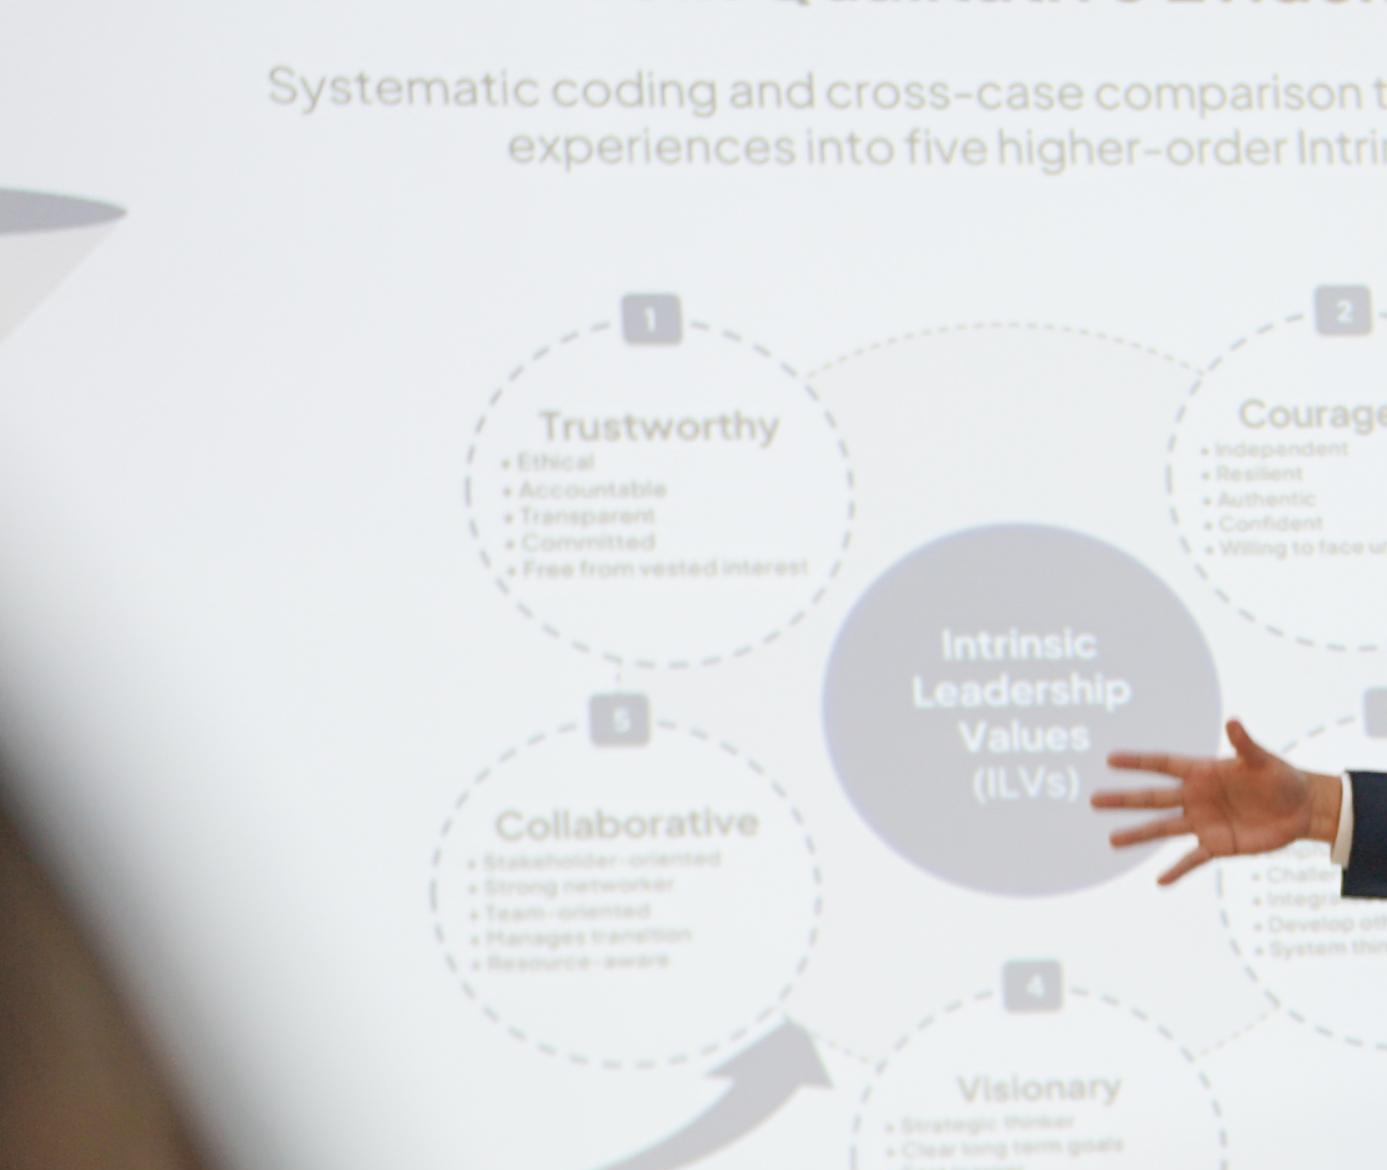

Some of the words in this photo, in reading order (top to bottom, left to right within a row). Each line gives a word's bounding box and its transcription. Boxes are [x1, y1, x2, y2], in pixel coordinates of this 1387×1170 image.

[267, 64, 540, 116] Systematic
[551, 69, 716, 119] coding
[729, 70, 814, 110] and
[826, 78, 1084, 111] cross-case
[1096, 73, 1363, 119] comparison
[507, 126, 796, 174] experiences
[806, 126, 895, 167] into
[904, 126, 988, 167] five
[998, 126, 1287, 176] higher-order
[644, 306, 656, 333] 1
[1337, 300, 1352, 324] 2
[538, 408, 782, 450] Trustworthy
[516, 452, 596, 472] Ethical
[1213, 441, 1350, 461] Independent
[1215, 465, 1304, 483] Resilient
[518, 480, 668, 500] Accountable
[1217, 490, 1317, 509] Authentic
[521, 506, 655, 528] Transparent
[1218, 515, 1323, 533] Confident
[521, 532, 656, 553] Committed
[1218, 538, 1288, 561] Willing
[1292, 539, 1316, 556] to
[1318, 538, 1366, 556] face
[523, 559, 574, 579] Free
[579, 558, 635, 578] from
[638, 557, 718, 577] vested
[722, 556, 808, 576] interest
[942, 625, 1097, 661] Intrinsic
[912, 669, 1132, 713] Leadership
[958, 718, 1090, 753] Values
[972, 764, 1080, 803] (ILVs)
[494, 805, 759, 843] Collaborative
[1267, 915, 1355, 934] Develop
[1026, 973, 1045, 998] 4
[956, 1073, 1123, 1108] Visionary
